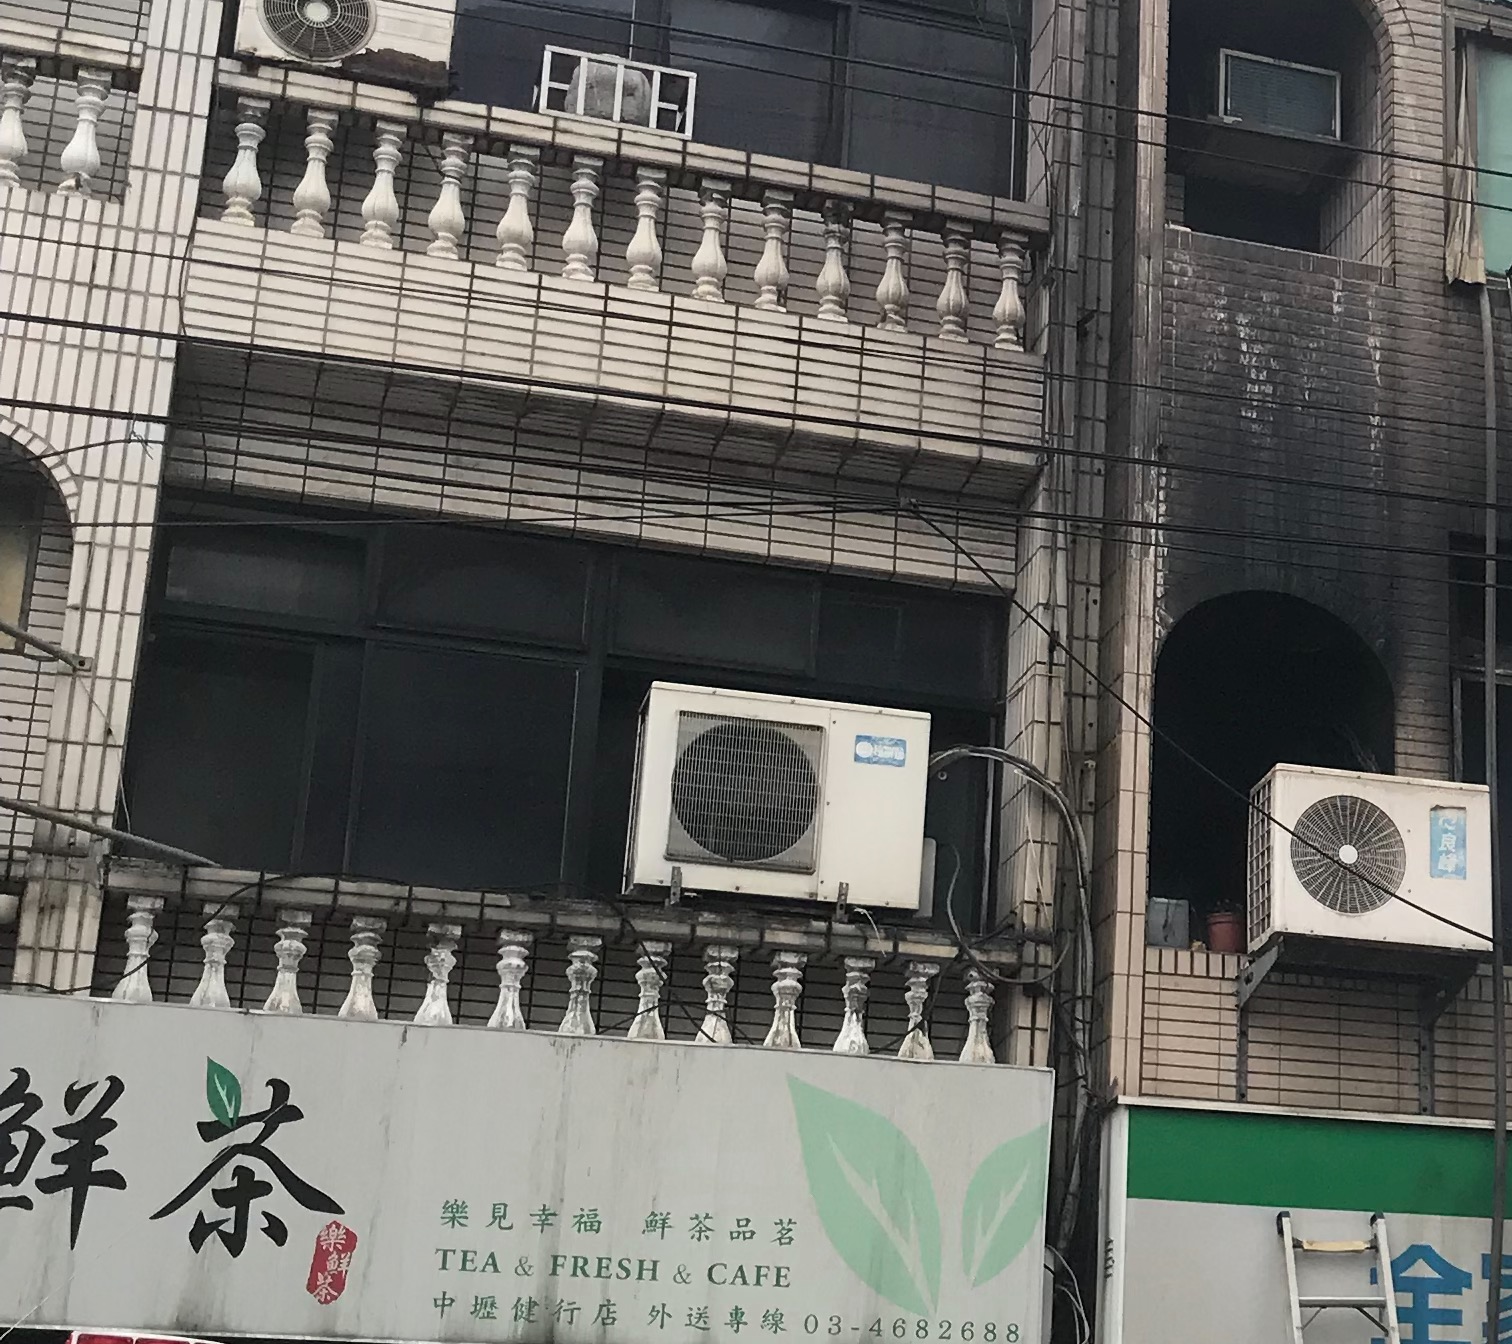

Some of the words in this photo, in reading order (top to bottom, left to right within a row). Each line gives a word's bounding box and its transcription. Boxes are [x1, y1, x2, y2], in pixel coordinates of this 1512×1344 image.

[440, 1197, 603, 1235] 樂見幸福
[641, 1209, 797, 1247] 鮮茶品茗
[435, 1247, 502, 1274] TEA
[514, 1255, 534, 1277] &
[549, 1254, 660, 1282] FRESH
[672, 1263, 692, 1285] &
[707, 1262, 791, 1289] CAFE
[432, 1291, 619, 1327] 中壢健行店
[804, 1312, 1020, 1344] 03-4682688
